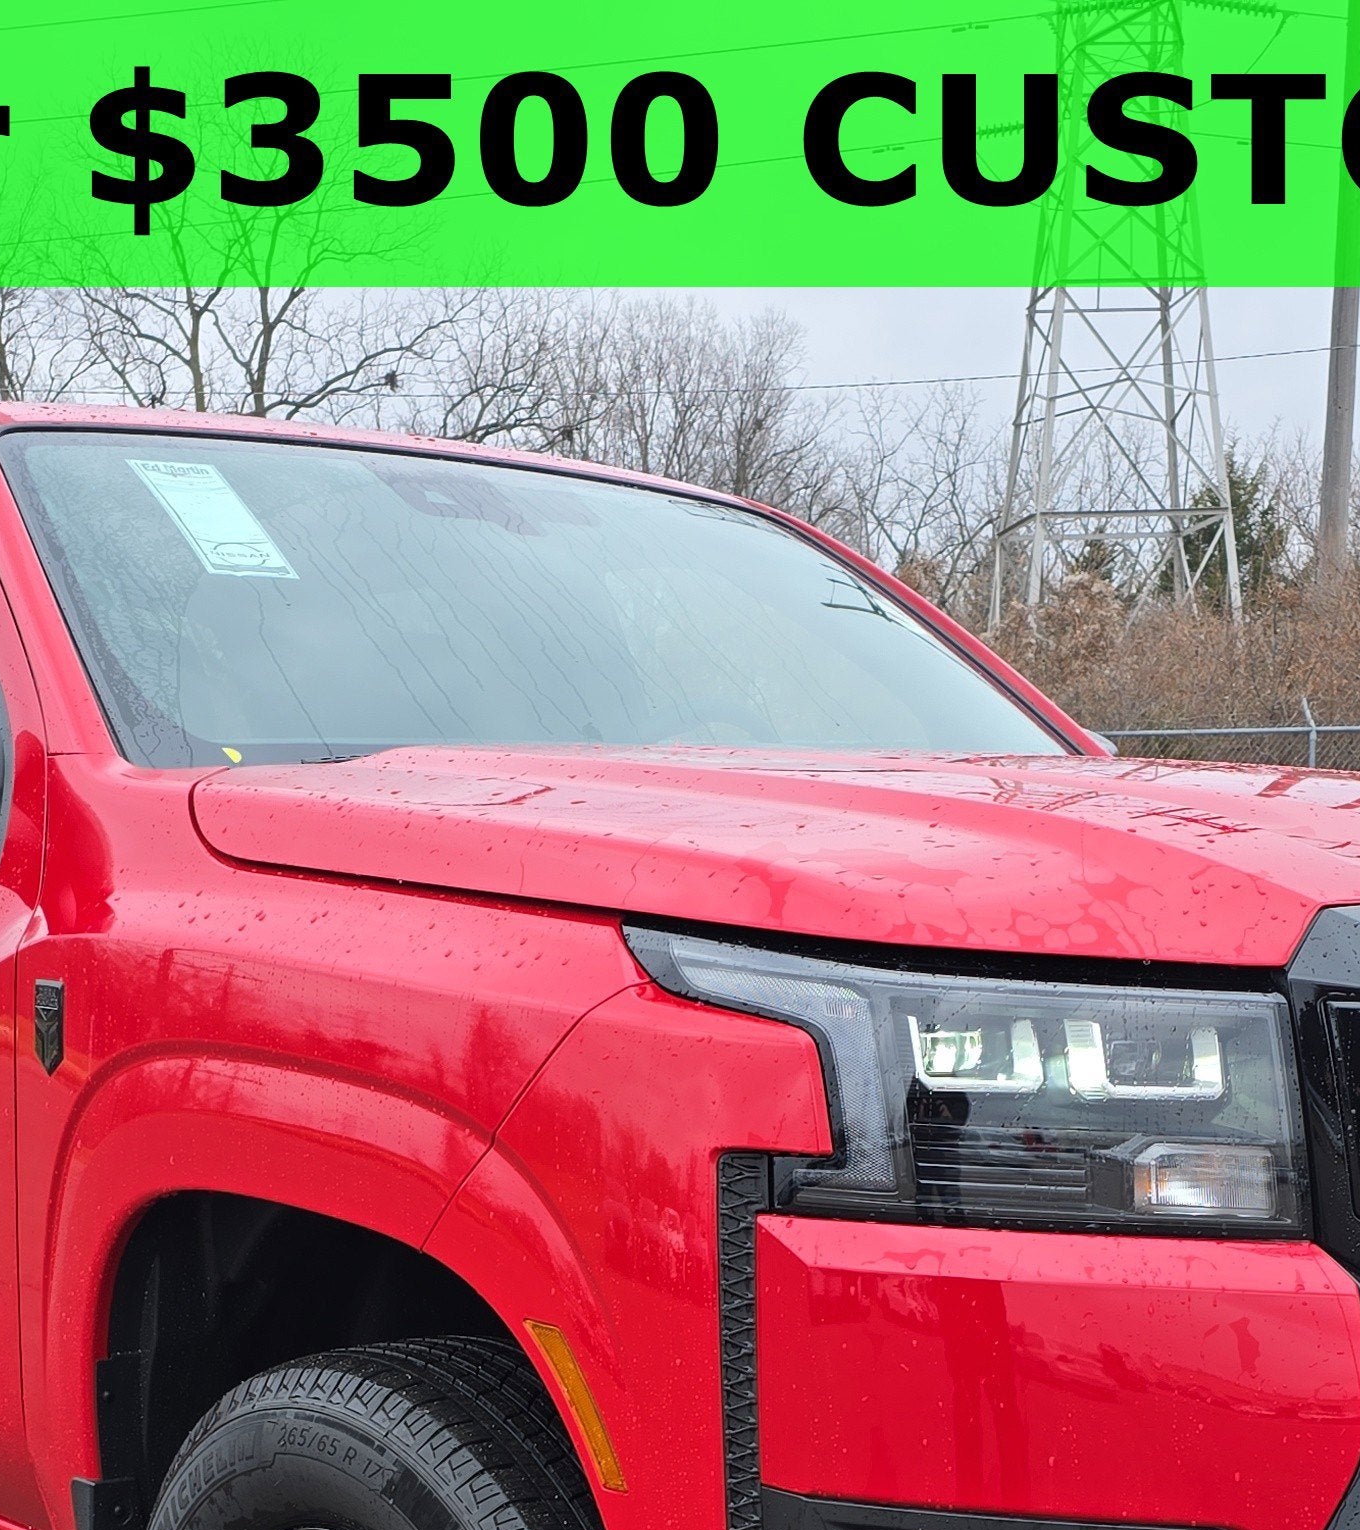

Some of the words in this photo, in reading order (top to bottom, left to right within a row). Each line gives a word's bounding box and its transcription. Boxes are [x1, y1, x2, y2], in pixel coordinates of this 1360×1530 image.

[210, 550, 270, 559] NISSAN
[278, 1423, 341, 1457] 265/65
[342, 1446, 358, 1466] R
[362, 1457, 383, 1480] 17
